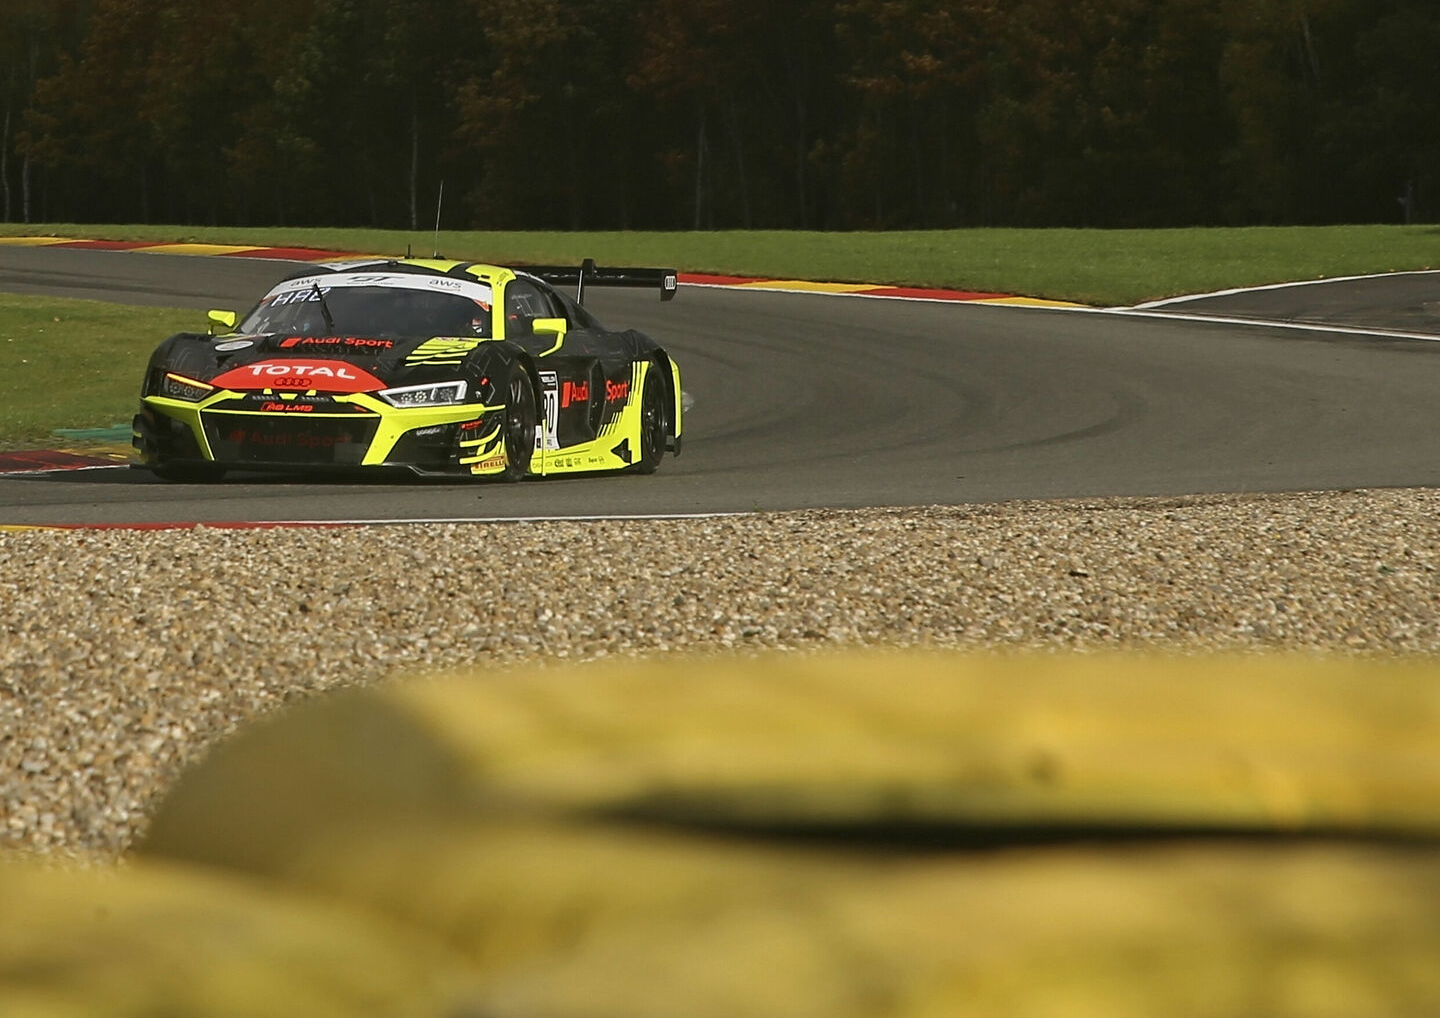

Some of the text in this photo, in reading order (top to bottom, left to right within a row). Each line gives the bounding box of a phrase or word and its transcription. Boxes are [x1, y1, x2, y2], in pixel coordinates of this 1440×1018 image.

[429, 279, 462, 289] aws
[302, 336, 394, 349] Audi Sport
[247, 363, 356, 380] TOTAL
[570, 379, 630, 404] Audi Sport
